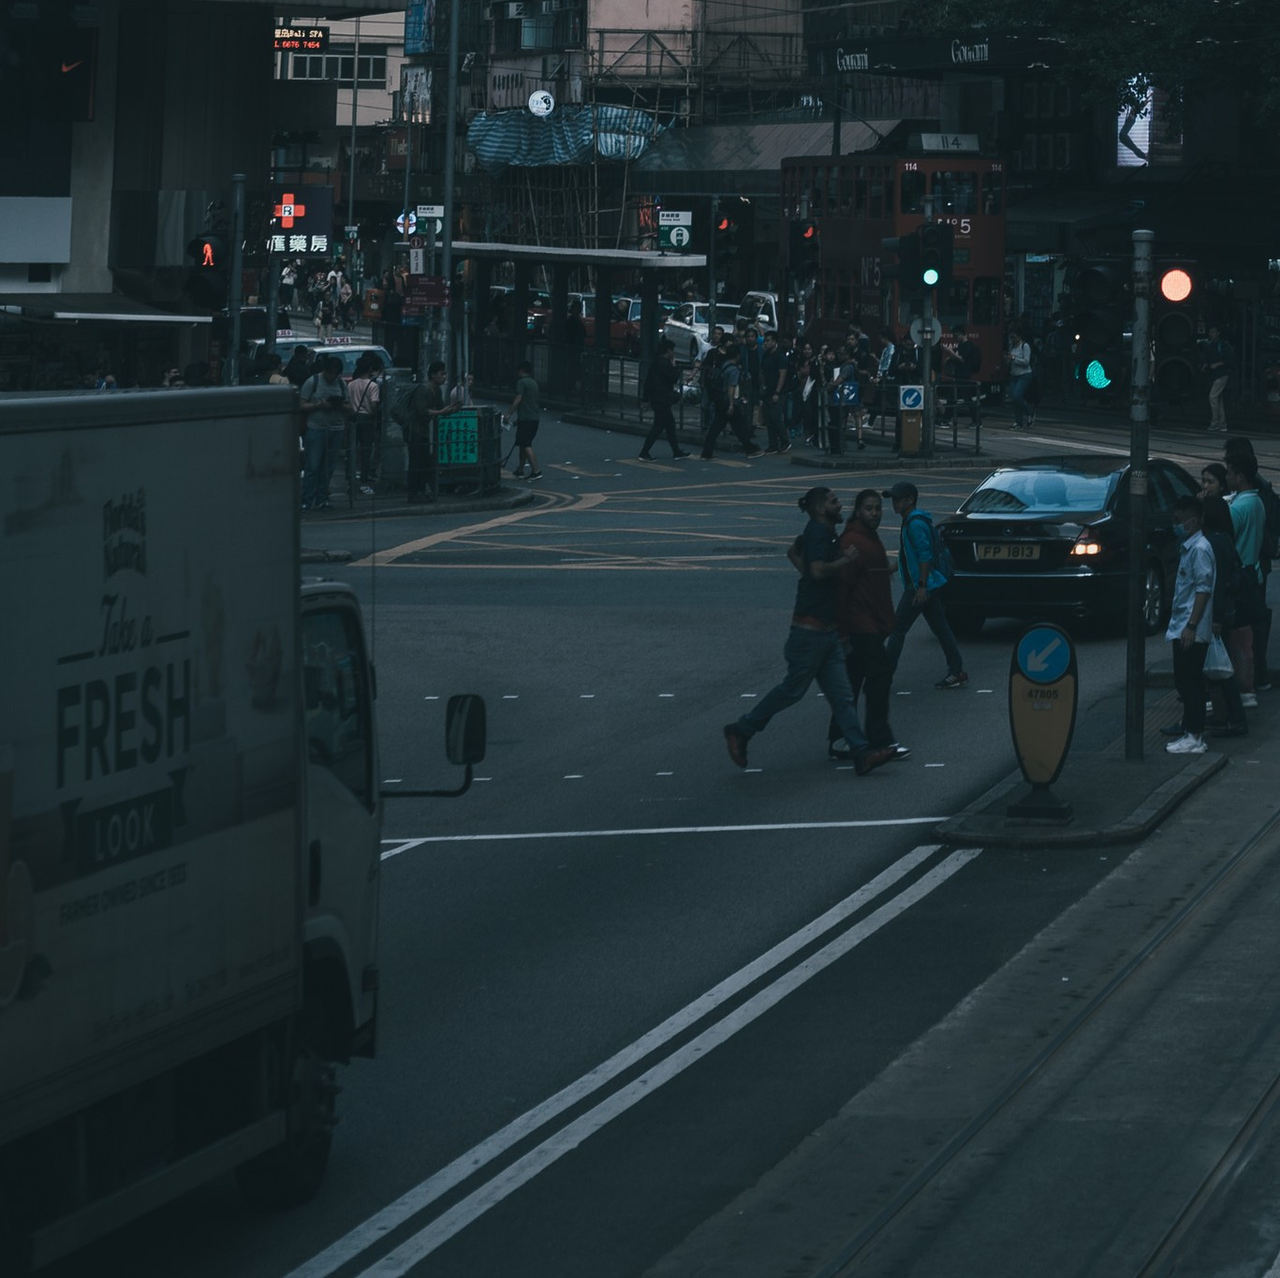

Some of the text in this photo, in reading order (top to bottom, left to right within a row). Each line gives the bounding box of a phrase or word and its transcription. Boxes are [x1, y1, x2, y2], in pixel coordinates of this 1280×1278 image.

[941, 135, 961, 149] 114
[905, 162, 918, 171] 114
[326, 336, 351, 345] TAXI
[983, 545, 1034, 558] FP 1813
[99, 593, 152, 657] Take a
[57, 659, 191, 789] FRESH
[95, 803, 156, 861] LOOK
